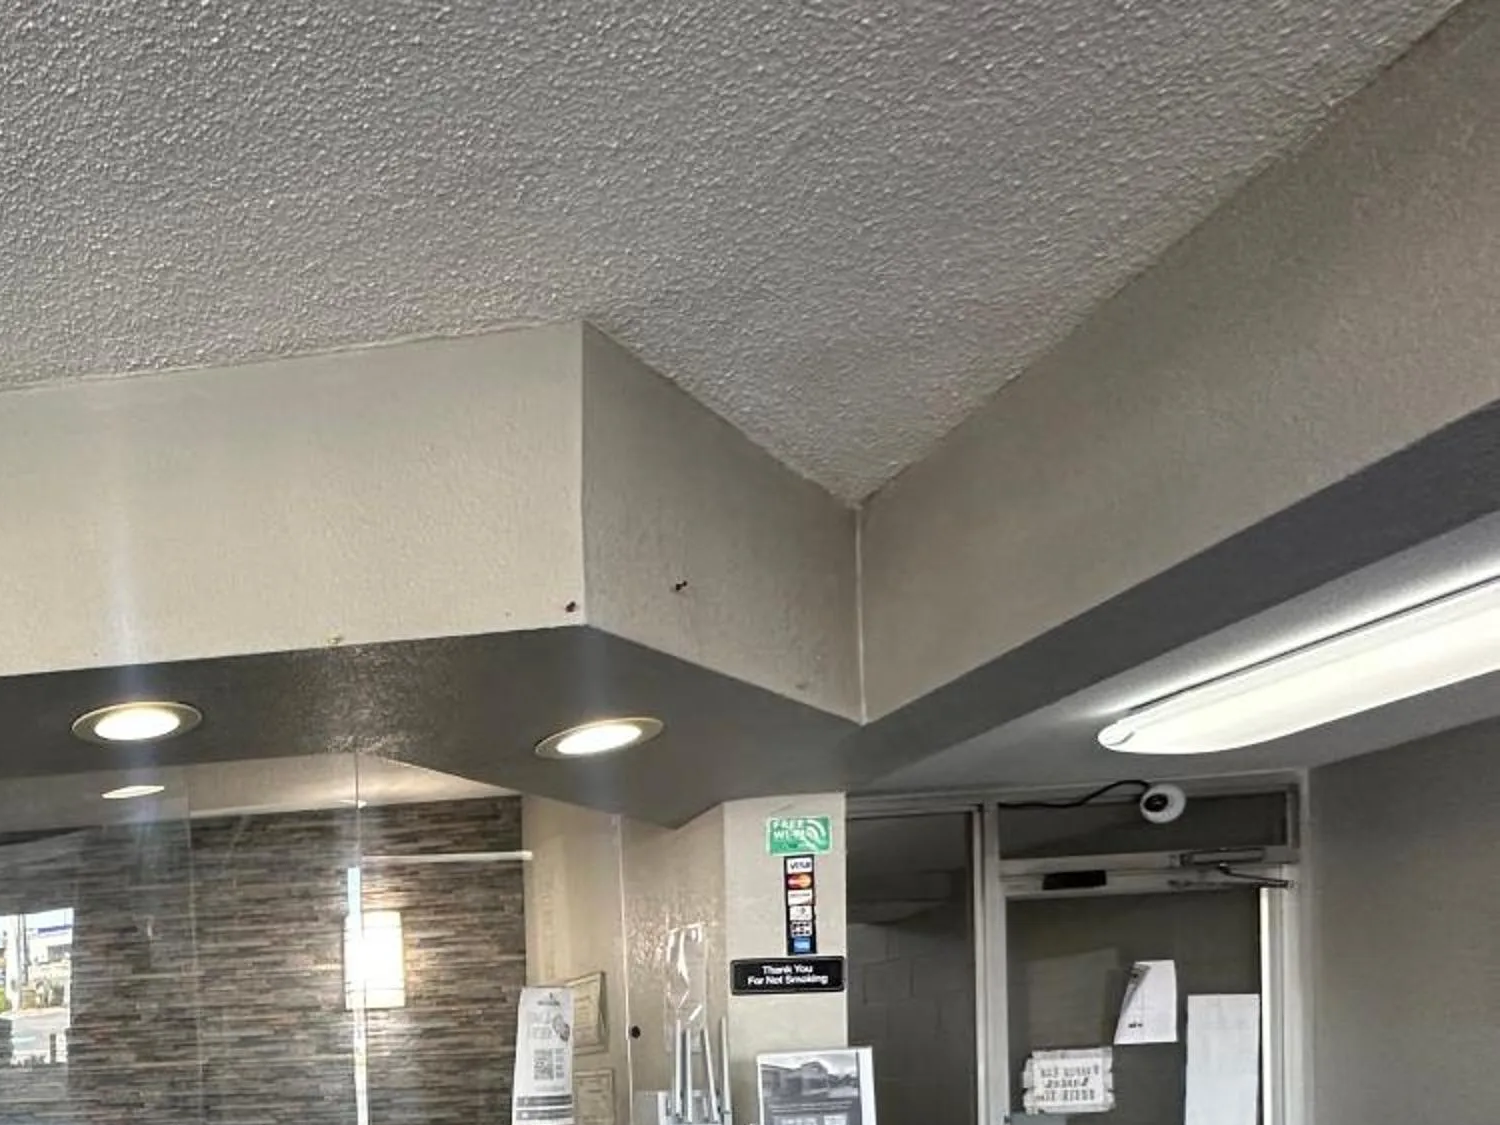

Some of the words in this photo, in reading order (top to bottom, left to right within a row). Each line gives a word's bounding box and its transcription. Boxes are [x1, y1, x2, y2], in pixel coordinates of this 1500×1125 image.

[761, 965, 792, 975] Thank
[794, 963, 814, 973] You
[747, 976, 764, 985] For
[765, 975, 783, 985] Not
[785, 974, 829, 986] Smoking
